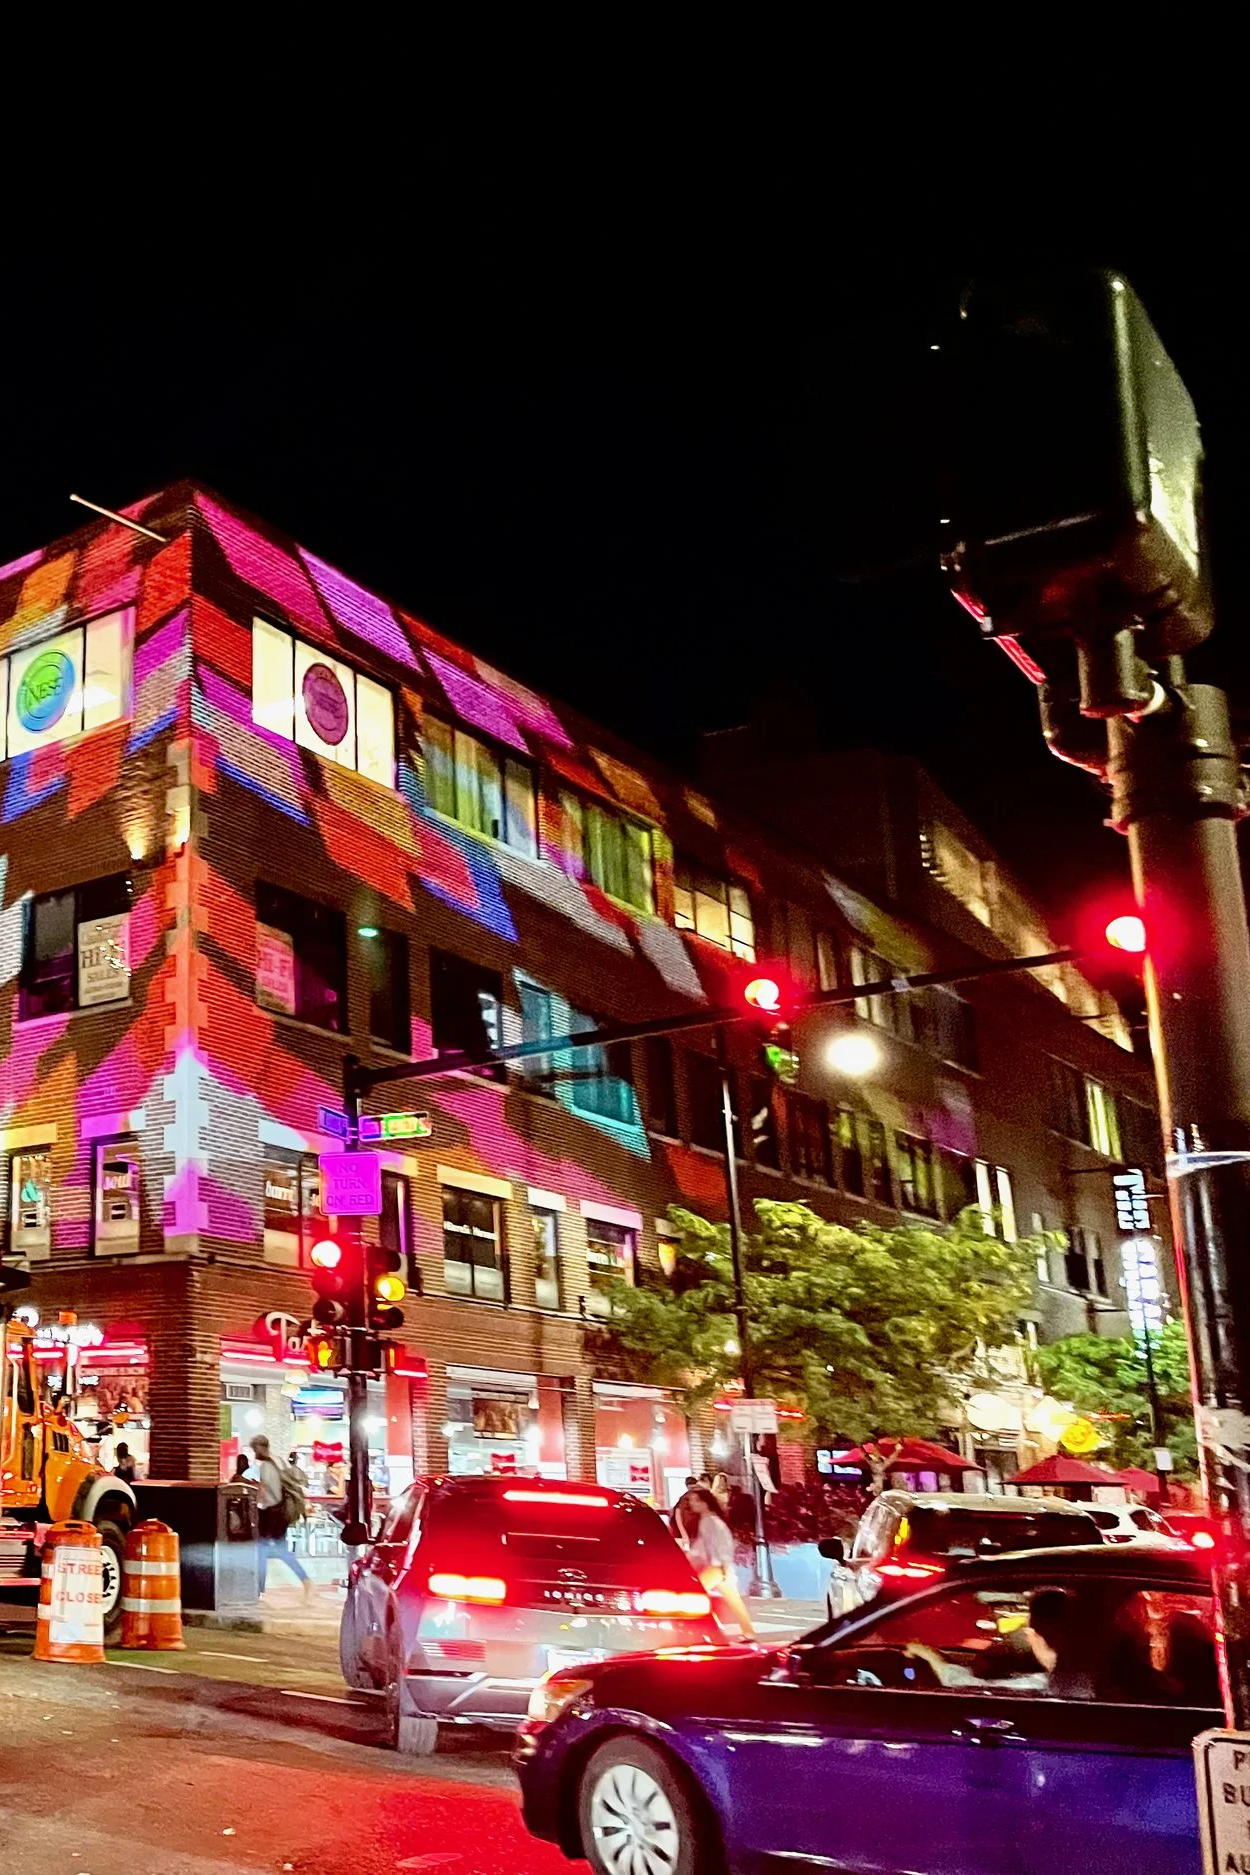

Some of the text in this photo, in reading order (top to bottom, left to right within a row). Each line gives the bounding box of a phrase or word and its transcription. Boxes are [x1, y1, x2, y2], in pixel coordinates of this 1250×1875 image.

[338, 1162, 358, 1173] NO
[333, 1178, 367, 1190] TURN
[326, 1194, 344, 1207] ON
[349, 1194, 375, 1206] RED
[57, 1562, 103, 1576] STREE
[56, 1591, 101, 1604] CLOSE
